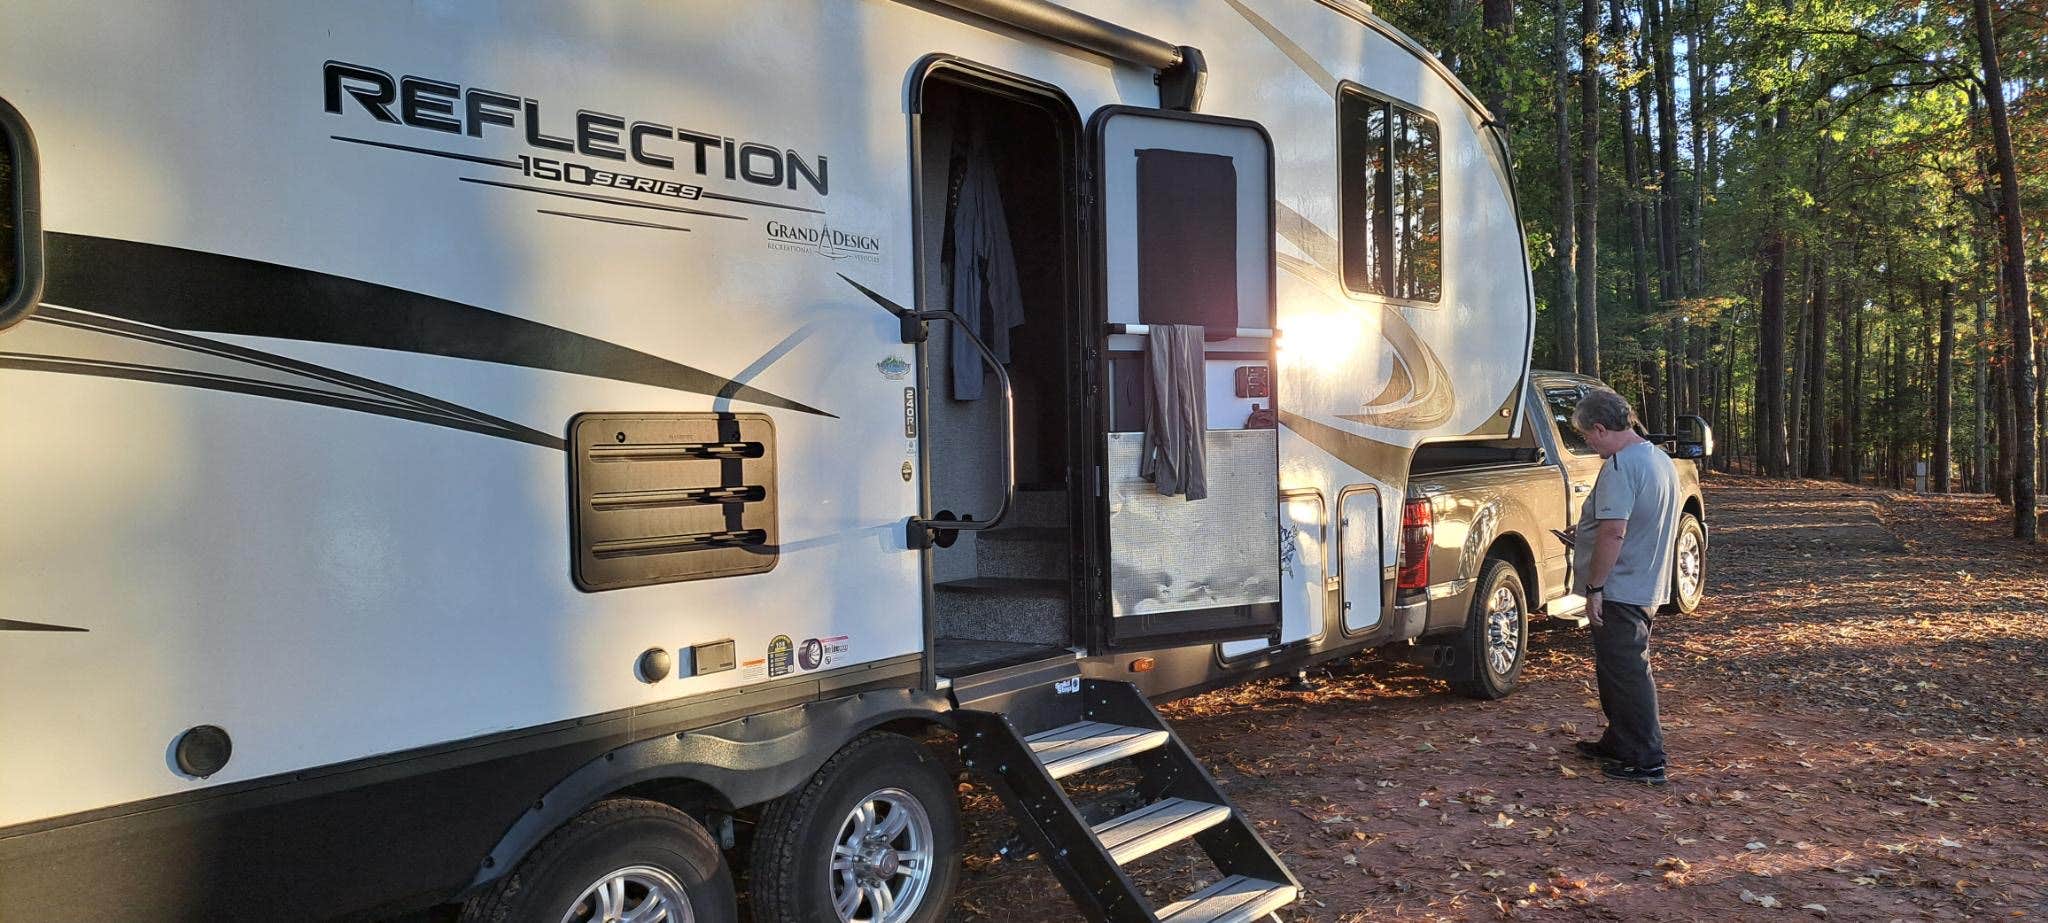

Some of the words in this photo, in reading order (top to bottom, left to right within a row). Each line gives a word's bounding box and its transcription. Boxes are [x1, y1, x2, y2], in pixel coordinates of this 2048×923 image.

[323, 60, 828, 196] REFLECTION
[518, 154, 590, 186] 150
[592, 171, 699, 199] SERIES
[766, 220, 819, 242] GRAND
[833, 230, 879, 250] DESIGN
